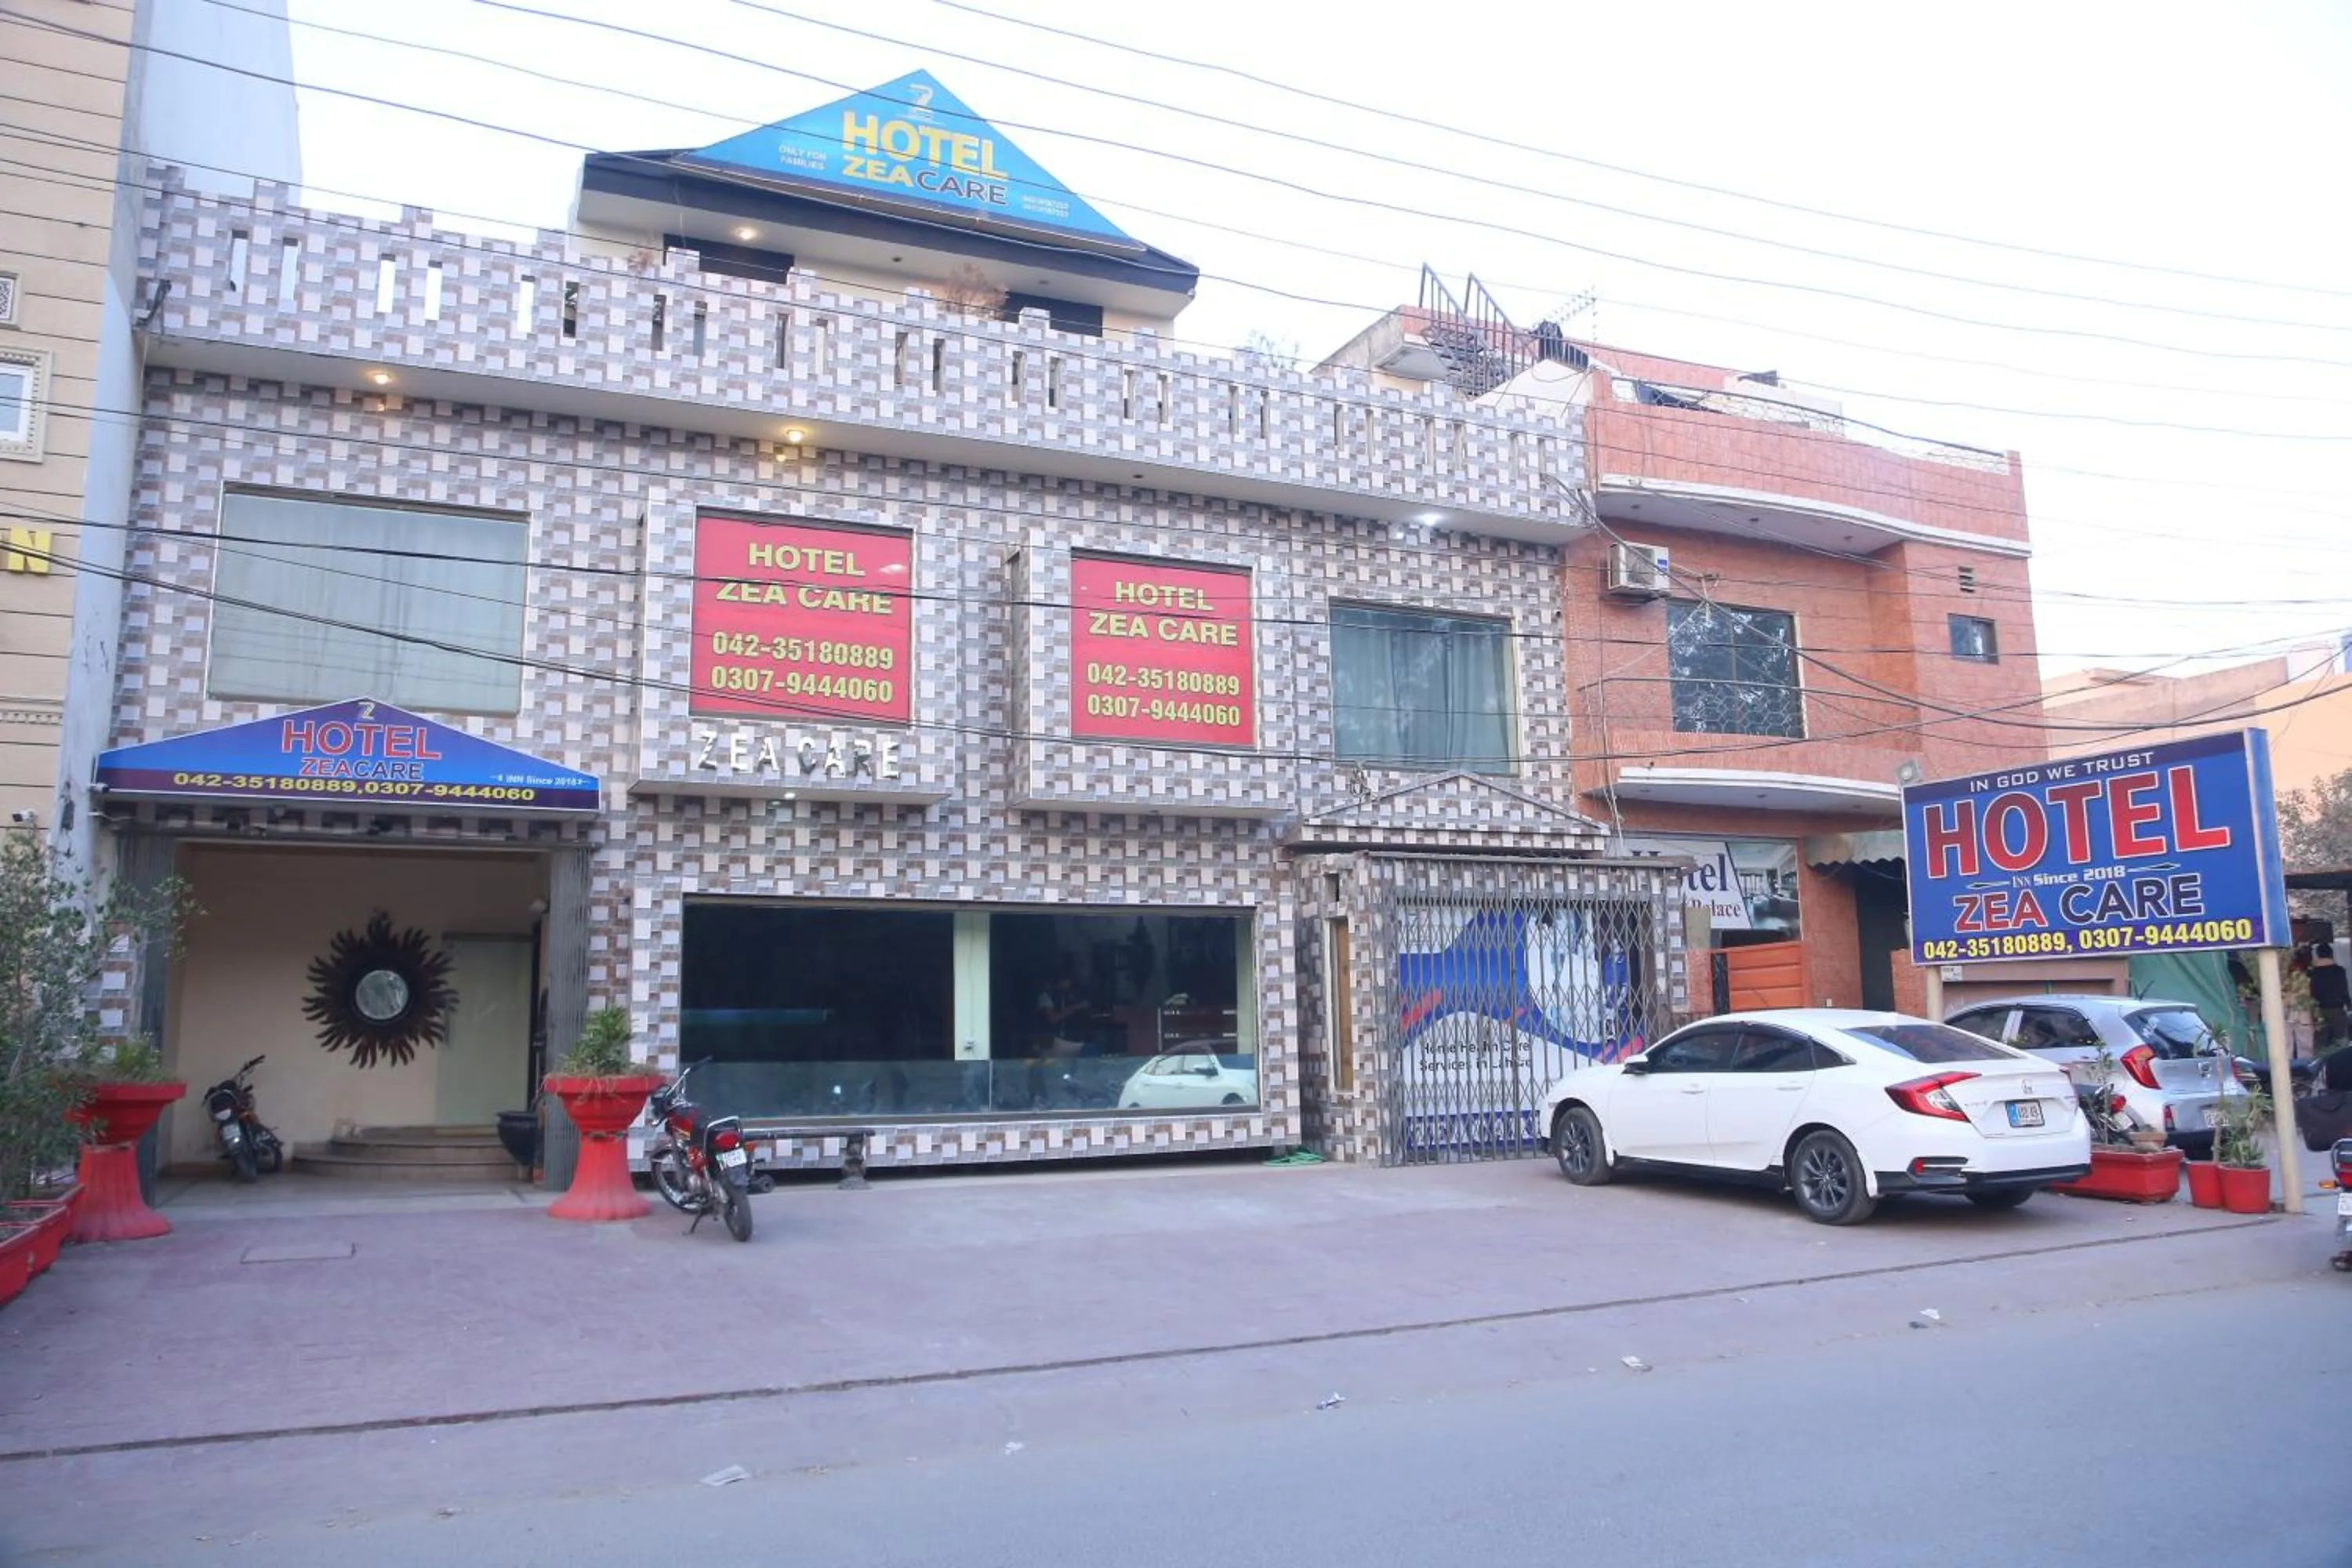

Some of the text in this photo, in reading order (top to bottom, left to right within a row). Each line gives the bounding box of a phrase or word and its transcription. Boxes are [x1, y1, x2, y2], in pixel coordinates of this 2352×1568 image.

[842, 110, 1009, 181] HOTEL
[748, 543, 866, 576] HOTEL
[716, 577, 893, 614] ZEA CARE
[1115, 581, 1214, 612] HOTEL
[1088, 612, 1239, 646] ZEA CARE
[712, 631, 894, 670] 042-35180889
[711, 666, 893, 703] 0307-9444060
[1087, 662, 1240, 696] 042-35180889
[1087, 694, 1240, 727] 0307-9444060
[281, 719, 442, 760] HOTEL
[697, 730, 901, 779] ZEA CARE
[1970, 752, 2154, 793] IN GOD WE TRUST
[1924, 764, 2230, 879] HOTEL
[2033, 872, 2078, 886] Since
[2083, 865, 2126, 881] 2018
[1953, 873, 2205, 934] ZEA CARE
[2079, 917, 2252, 950] 0307-9444060
